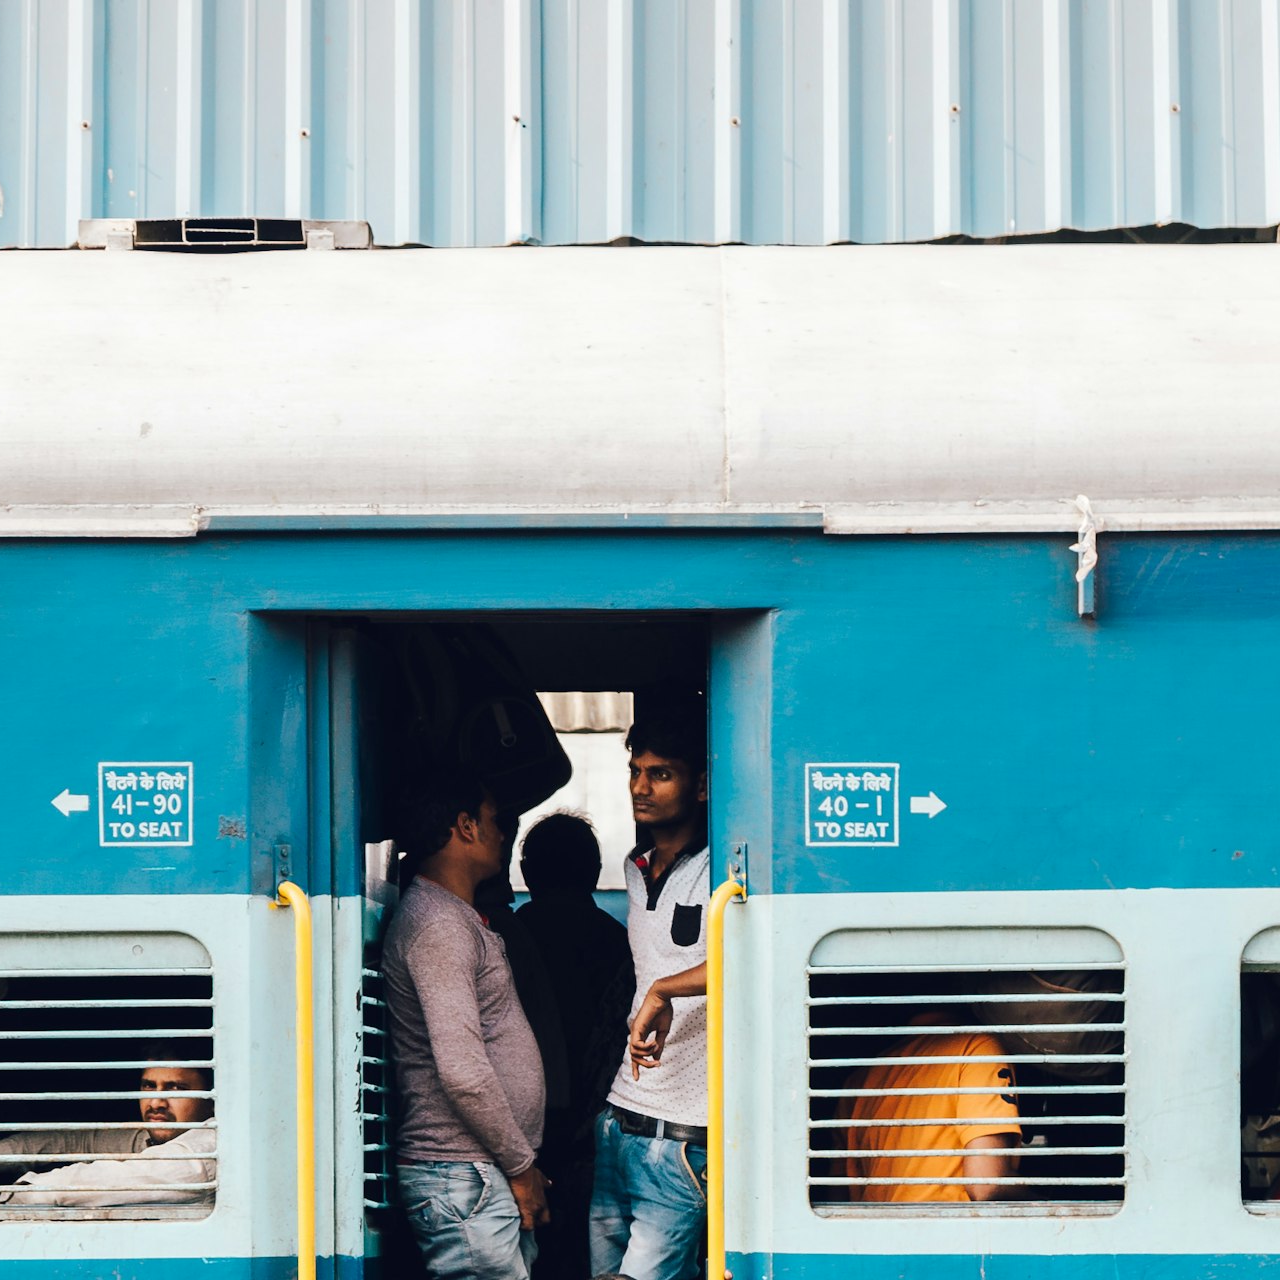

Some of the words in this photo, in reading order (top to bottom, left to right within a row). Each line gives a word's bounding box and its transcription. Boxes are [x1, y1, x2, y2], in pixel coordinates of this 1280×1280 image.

[104, 770, 138, 791] बैठने
[139, 771, 155, 790] के
[811, 770, 845, 791] बैठने
[845, 772, 861, 791] के
[109, 821, 136, 838] TO
[138, 821, 183, 838] SEAT
[814, 821, 842, 838] TO
[844, 821, 890, 838] SEAT
